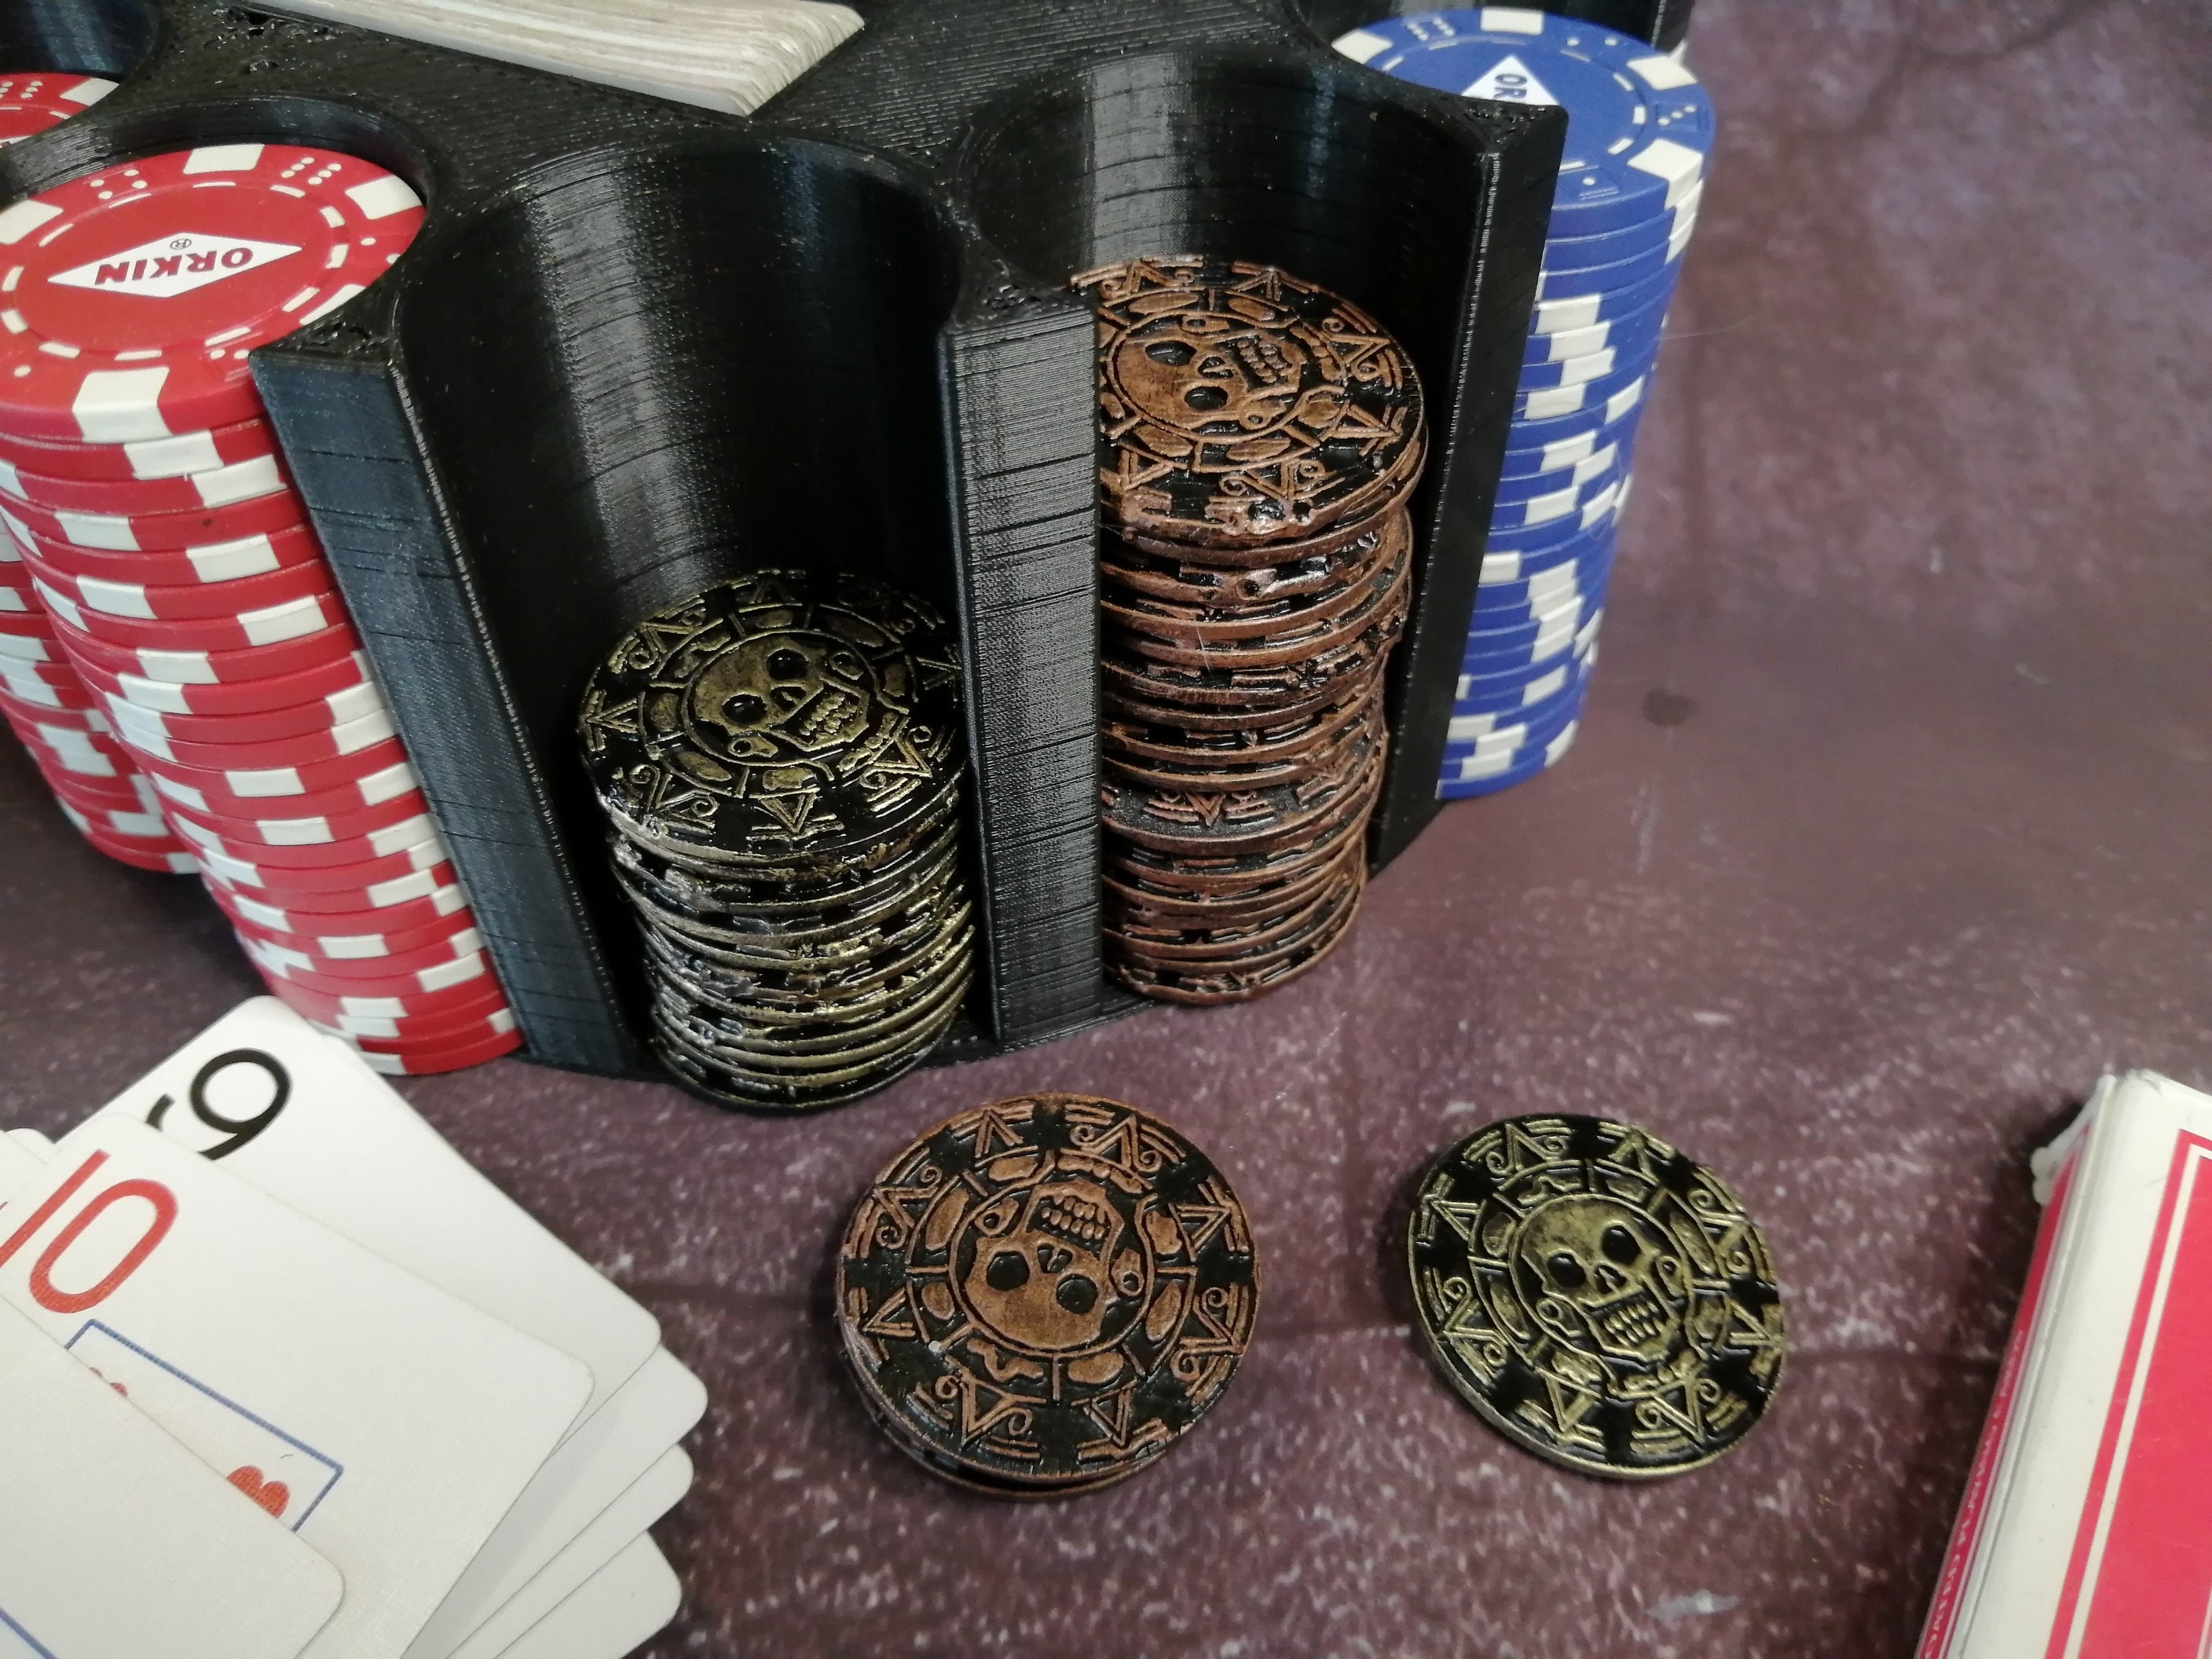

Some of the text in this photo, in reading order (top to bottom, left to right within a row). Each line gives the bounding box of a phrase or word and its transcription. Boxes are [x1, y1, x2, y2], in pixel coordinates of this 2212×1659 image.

[94, 247, 253, 285] ORKIN
[145, 1047, 292, 1161] 9
[0, 1148, 178, 1314] 10
